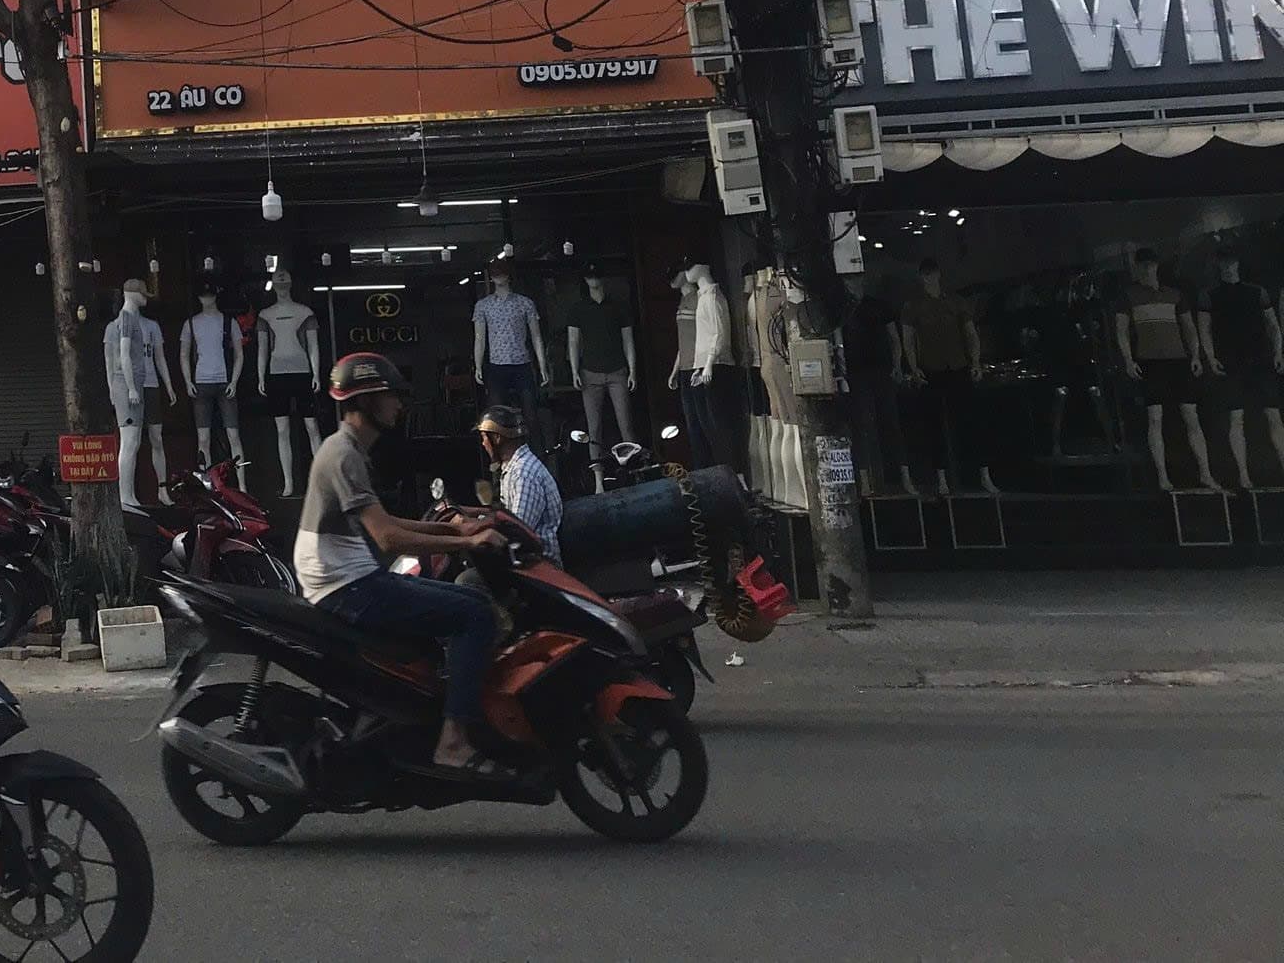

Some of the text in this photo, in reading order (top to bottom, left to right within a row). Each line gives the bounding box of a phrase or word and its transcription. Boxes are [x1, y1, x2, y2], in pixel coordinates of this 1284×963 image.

[520, 59, 658, 83] 0905.079.917
[149, 85, 242, 110] 22 ÂU CƠ
[349, 327, 418, 343] GUCCI
